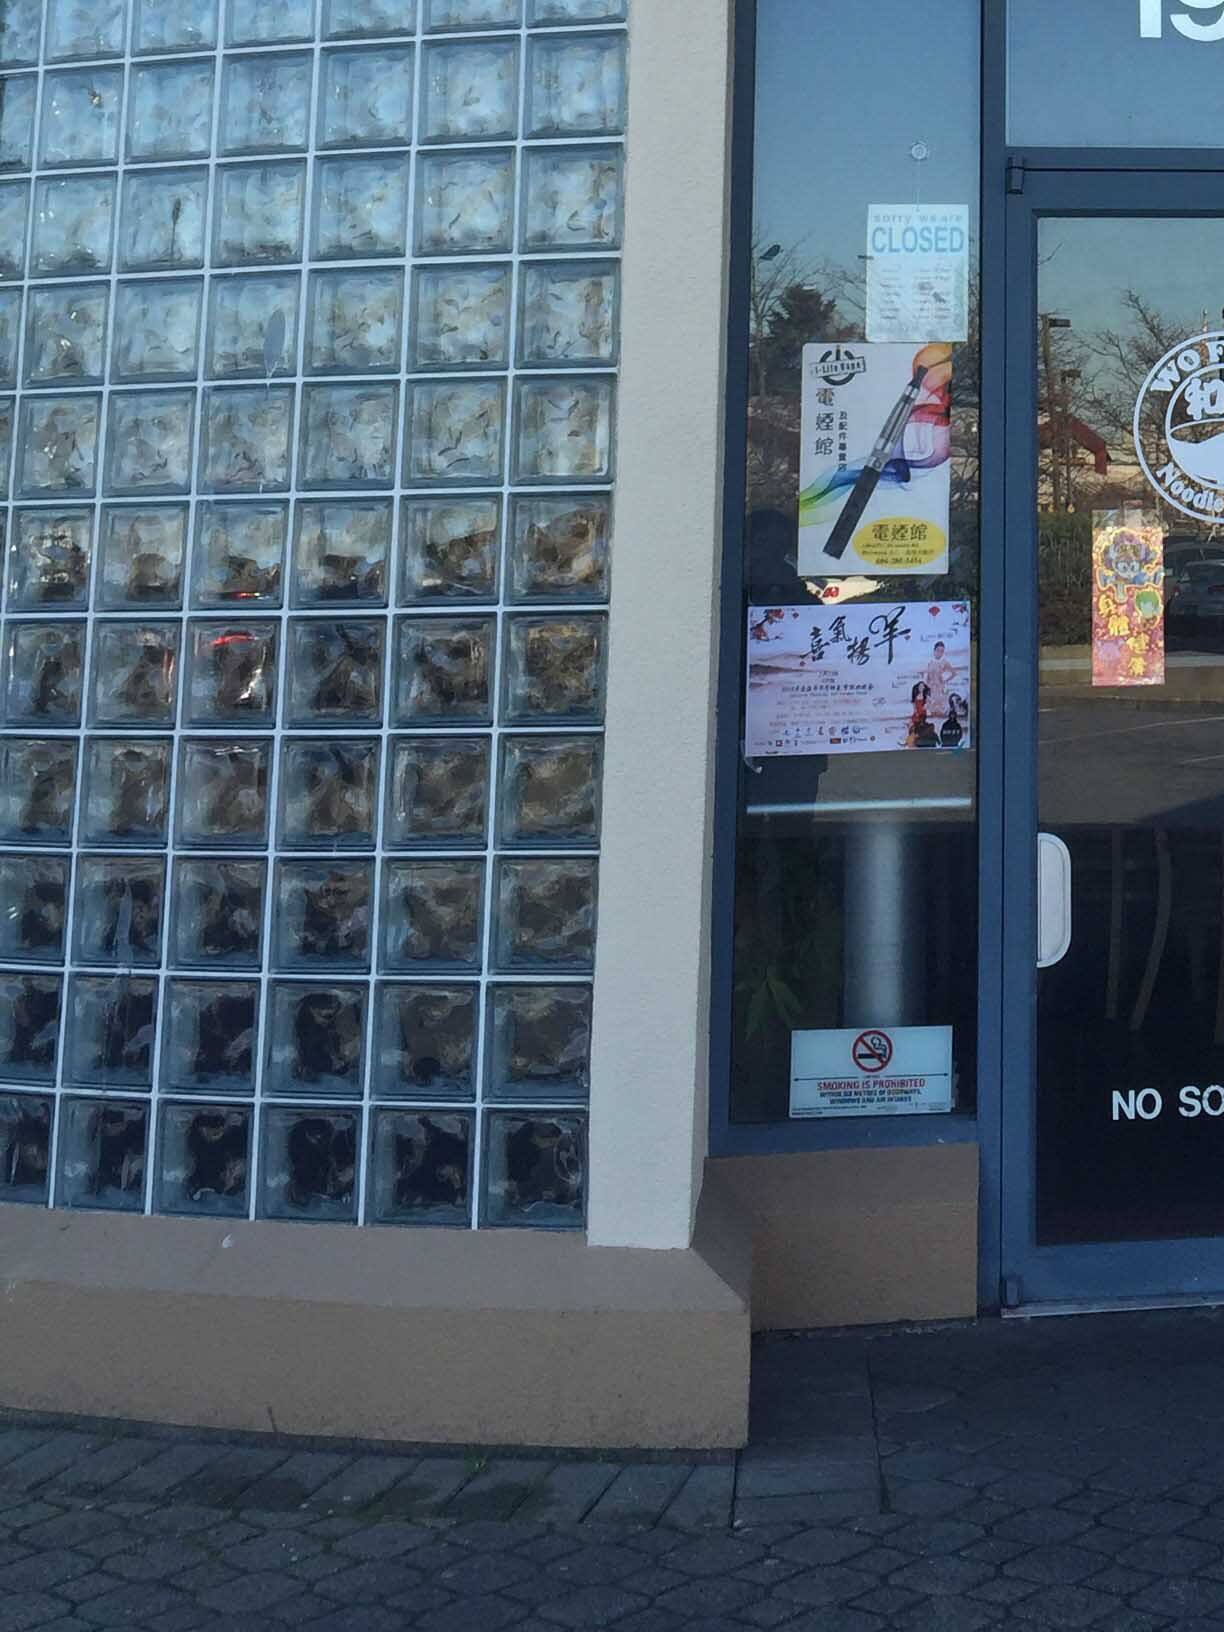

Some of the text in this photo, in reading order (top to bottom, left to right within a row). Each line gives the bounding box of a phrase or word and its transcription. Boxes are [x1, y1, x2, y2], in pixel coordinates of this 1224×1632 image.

[872, 226, 964, 253] CLOSED
[1150, 348, 1201, 392] WO
[1156, 461, 1224, 512] Noodle
[817, 1079, 926, 1090] SMOKING IS PROHIBITED
[1112, 1087, 1162, 1120] NO
